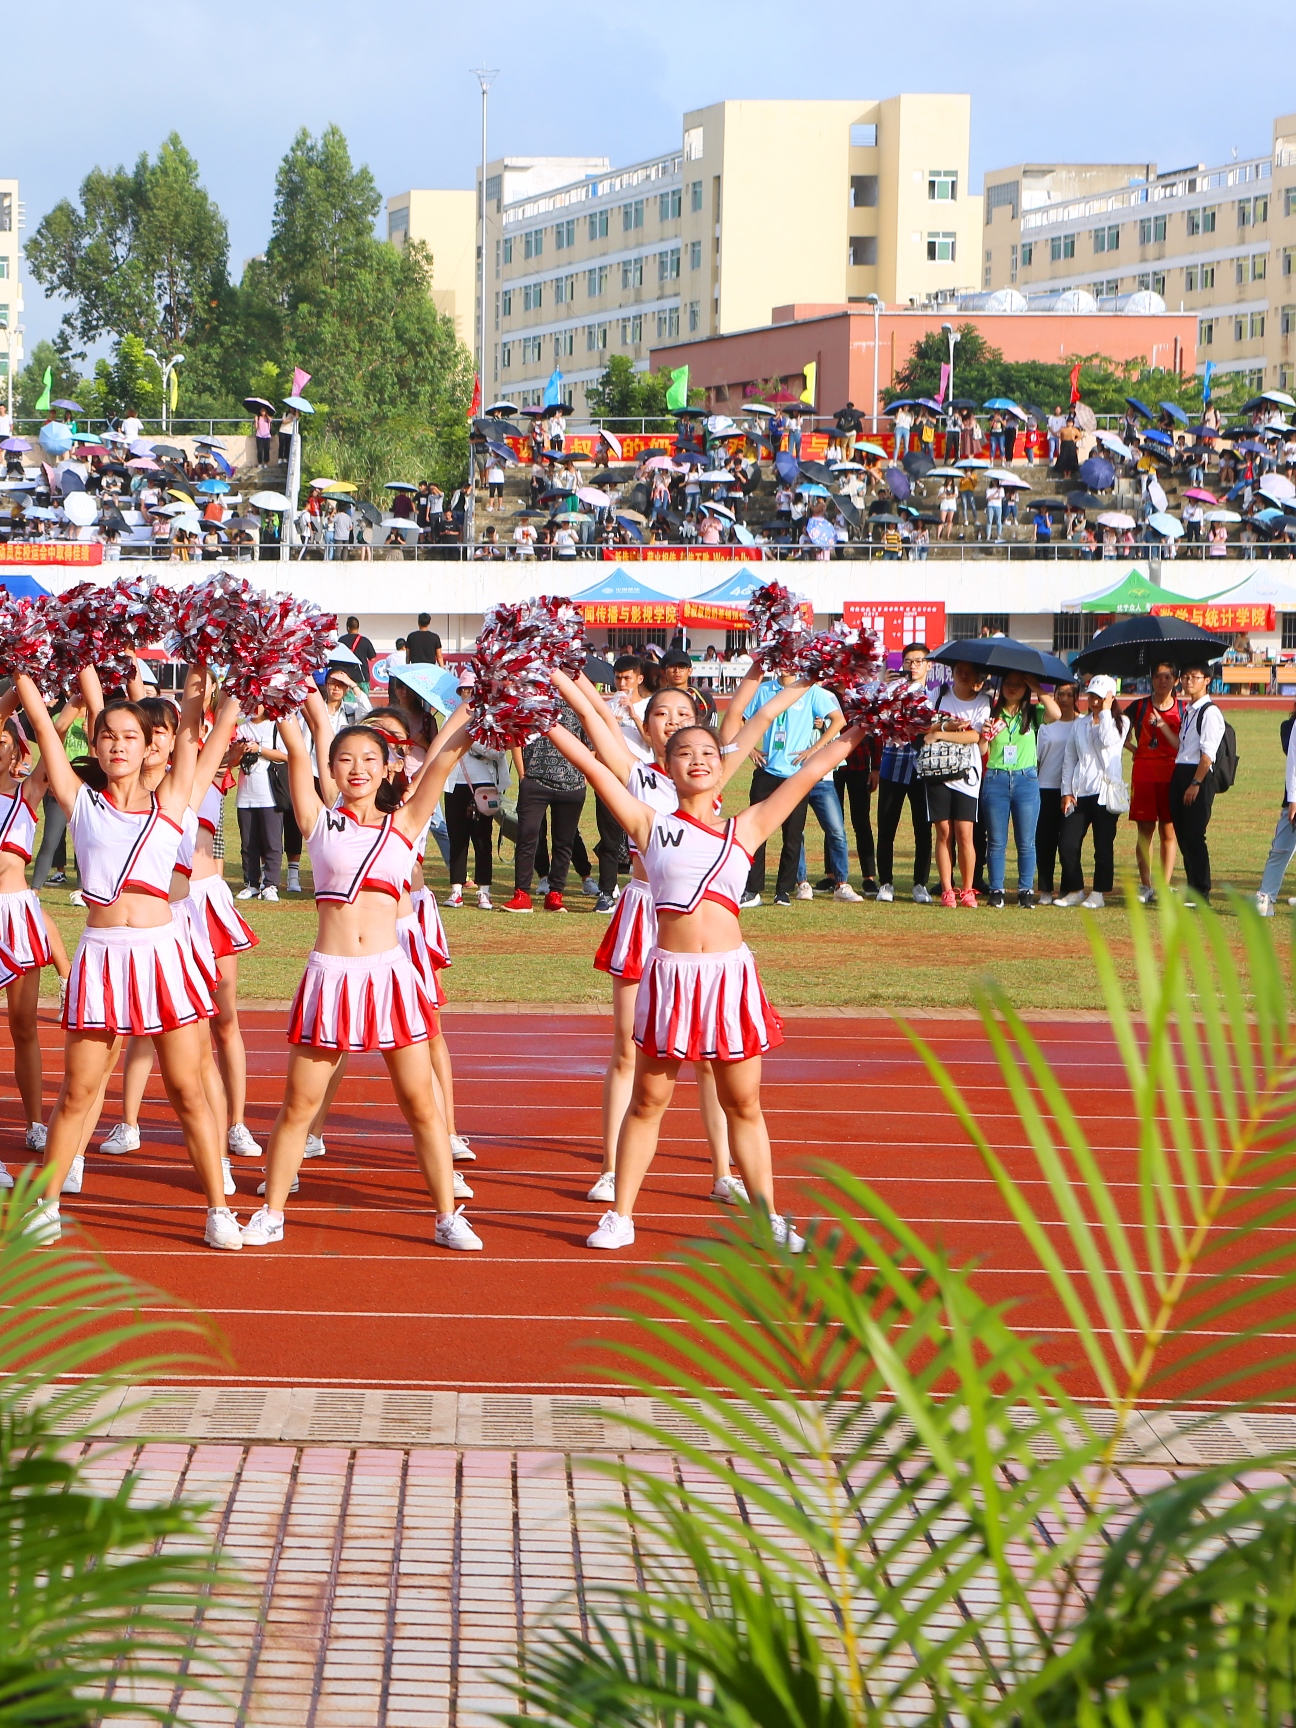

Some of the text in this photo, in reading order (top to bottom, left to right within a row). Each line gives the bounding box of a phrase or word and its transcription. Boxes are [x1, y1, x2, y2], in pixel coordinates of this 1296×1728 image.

[579, 604, 677, 624] 闻传播与影视学院
[637, 767, 657, 790] W
[326, 810, 346, 832] W
[657, 825, 685, 848] W
